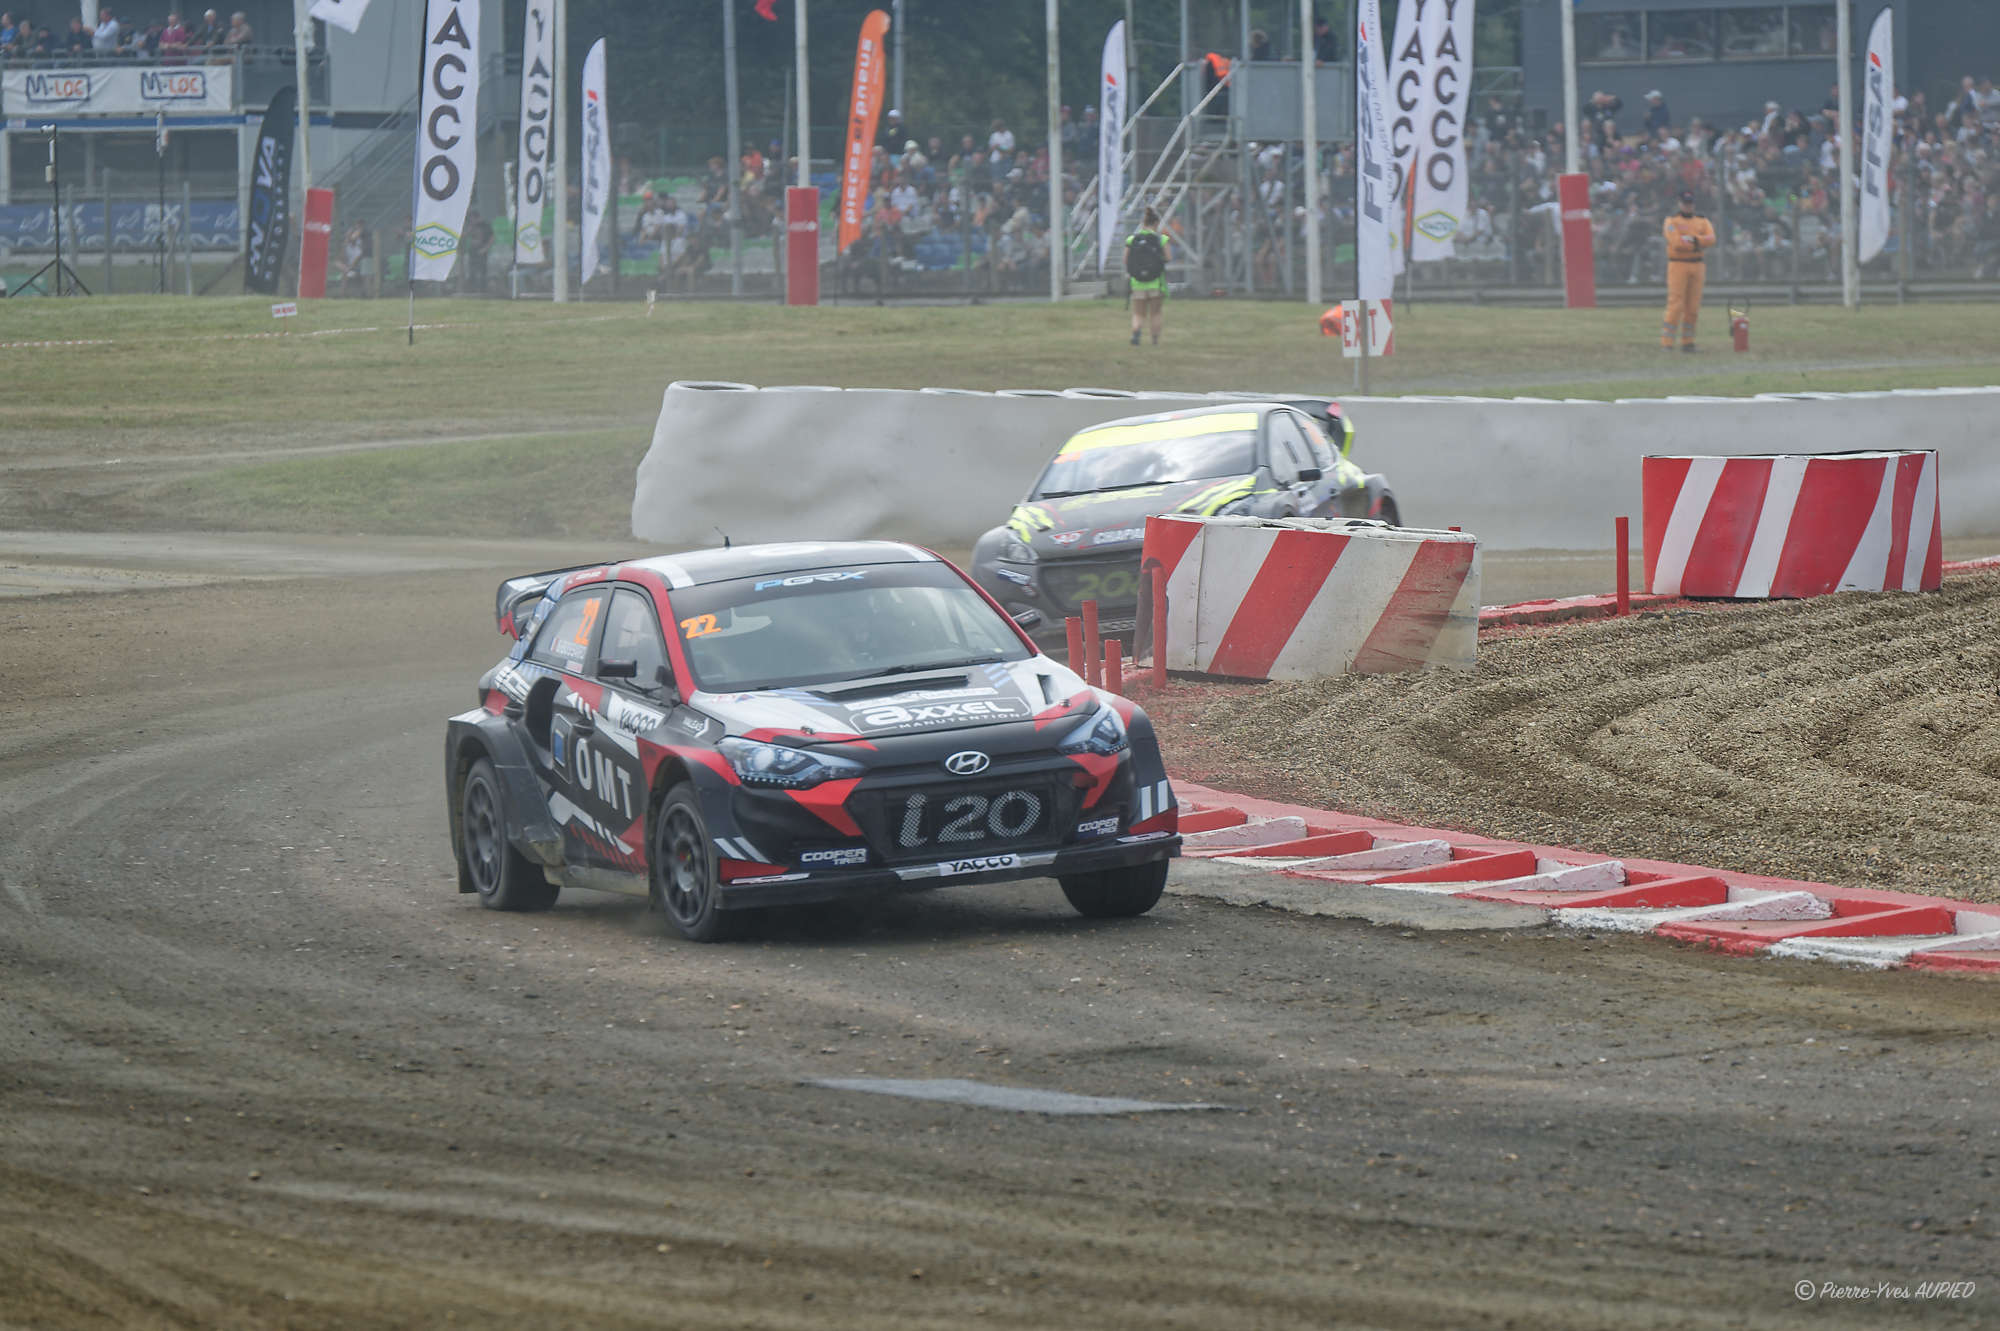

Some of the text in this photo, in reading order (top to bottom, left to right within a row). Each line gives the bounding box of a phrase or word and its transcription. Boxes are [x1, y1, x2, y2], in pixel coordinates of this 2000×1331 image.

[422, 0, 472, 201] ACCO
[416, 235, 455, 248] YACCO
[1343, 309, 1377, 348] EXT
[680, 614, 722, 639] 22
[899, 712, 1020, 729] MANUTENTION
[576, 738, 632, 820] OMT
[1078, 817, 1119, 832] COOPER
[801, 848, 867, 862] COOPER
[950, 856, 1013, 873] YACCO
